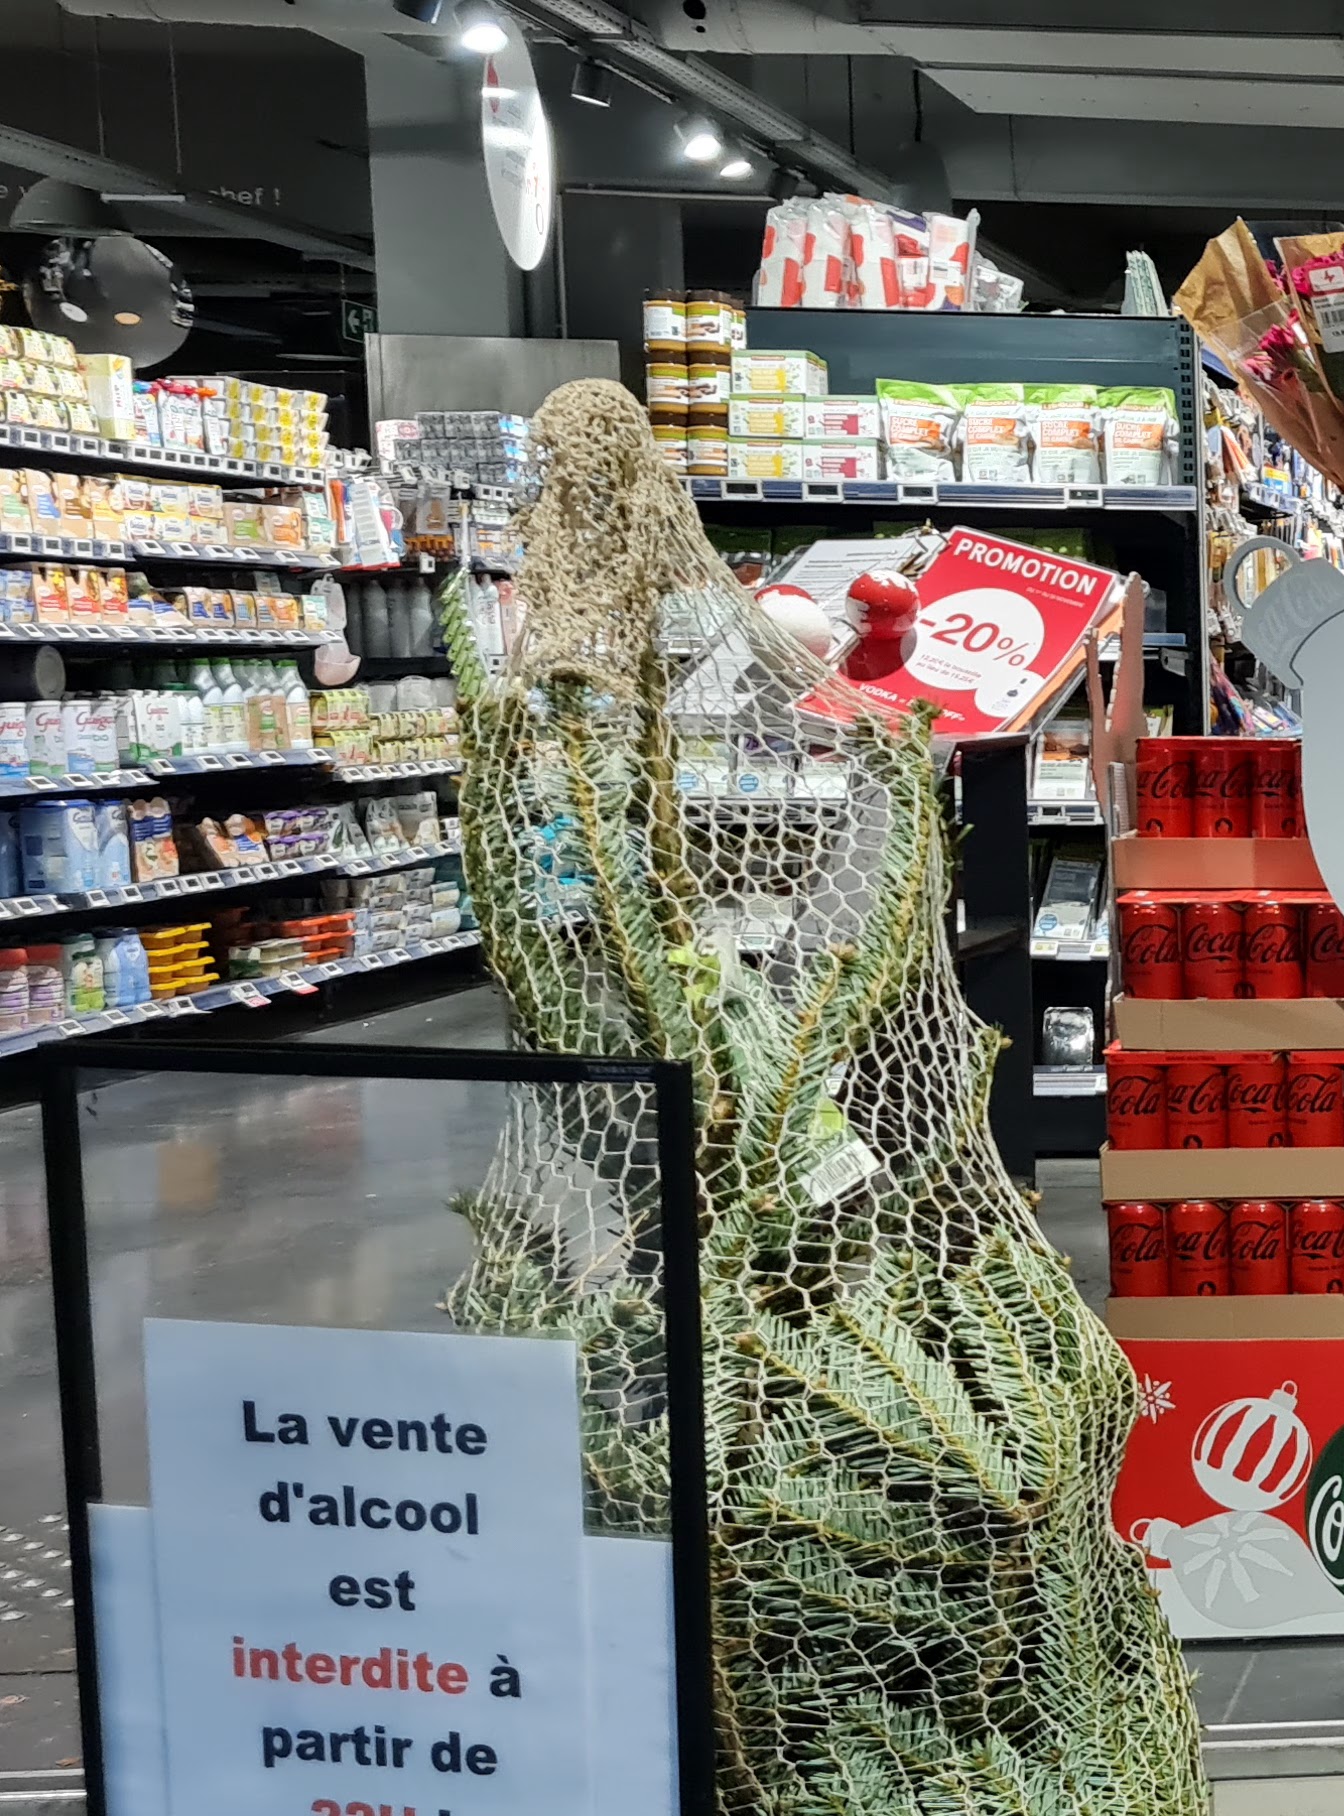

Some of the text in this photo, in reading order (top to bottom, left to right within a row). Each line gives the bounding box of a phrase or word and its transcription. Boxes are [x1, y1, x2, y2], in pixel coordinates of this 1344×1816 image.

[953, 537, 1098, 596] PROMOTION
[919, 612, 1026, 667] -20%
[858, 682, 898, 702] VODKA
[242, 1400, 488, 1457] La vente
[258, 1481, 479, 1535] d'alcool
[328, 1568, 416, 1612] est
[232, 1636, 522, 1699] interdite à
[262, 1724, 498, 1776] partir de
